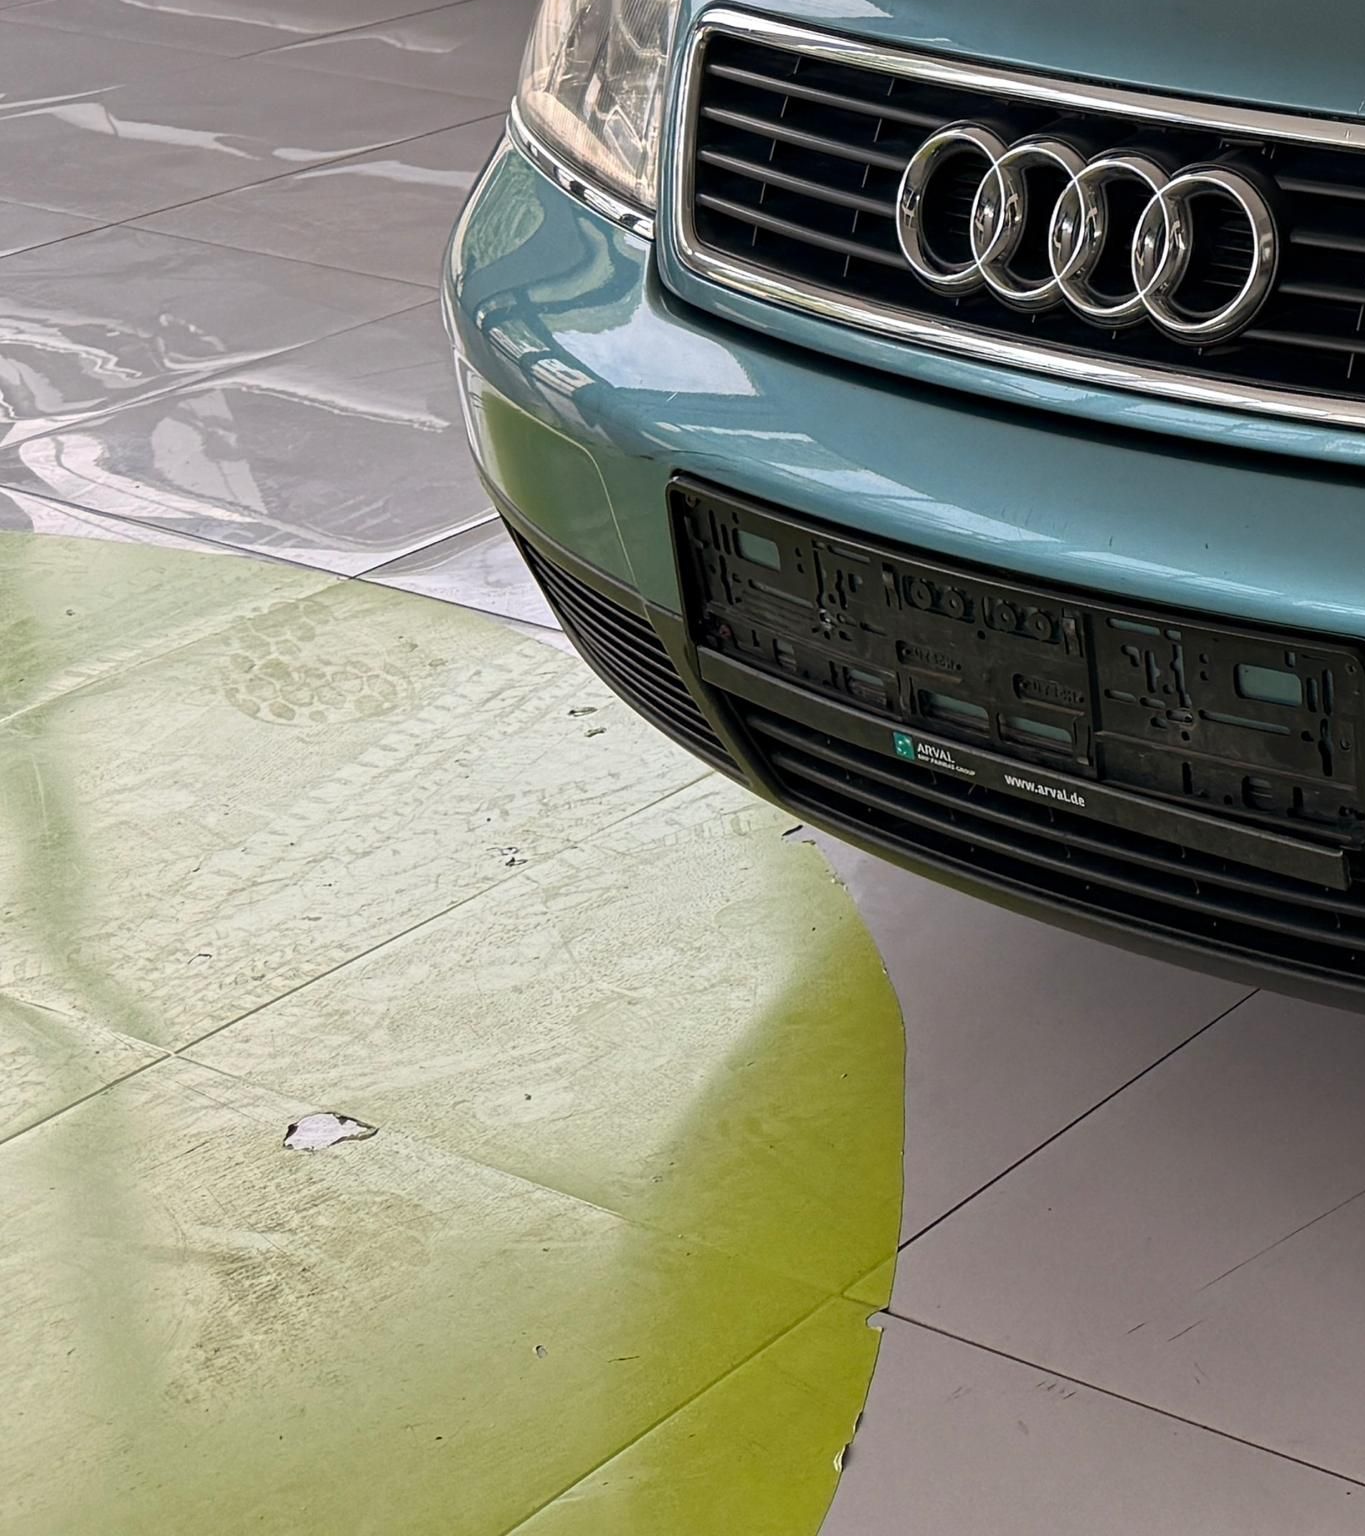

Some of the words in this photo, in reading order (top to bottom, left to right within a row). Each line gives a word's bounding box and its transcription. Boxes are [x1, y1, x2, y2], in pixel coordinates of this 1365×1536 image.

[917, 743, 956, 764] ARVAL
[955, 765, 976, 776] GROUP
[1004, 774, 1085, 807] www.arval.de
